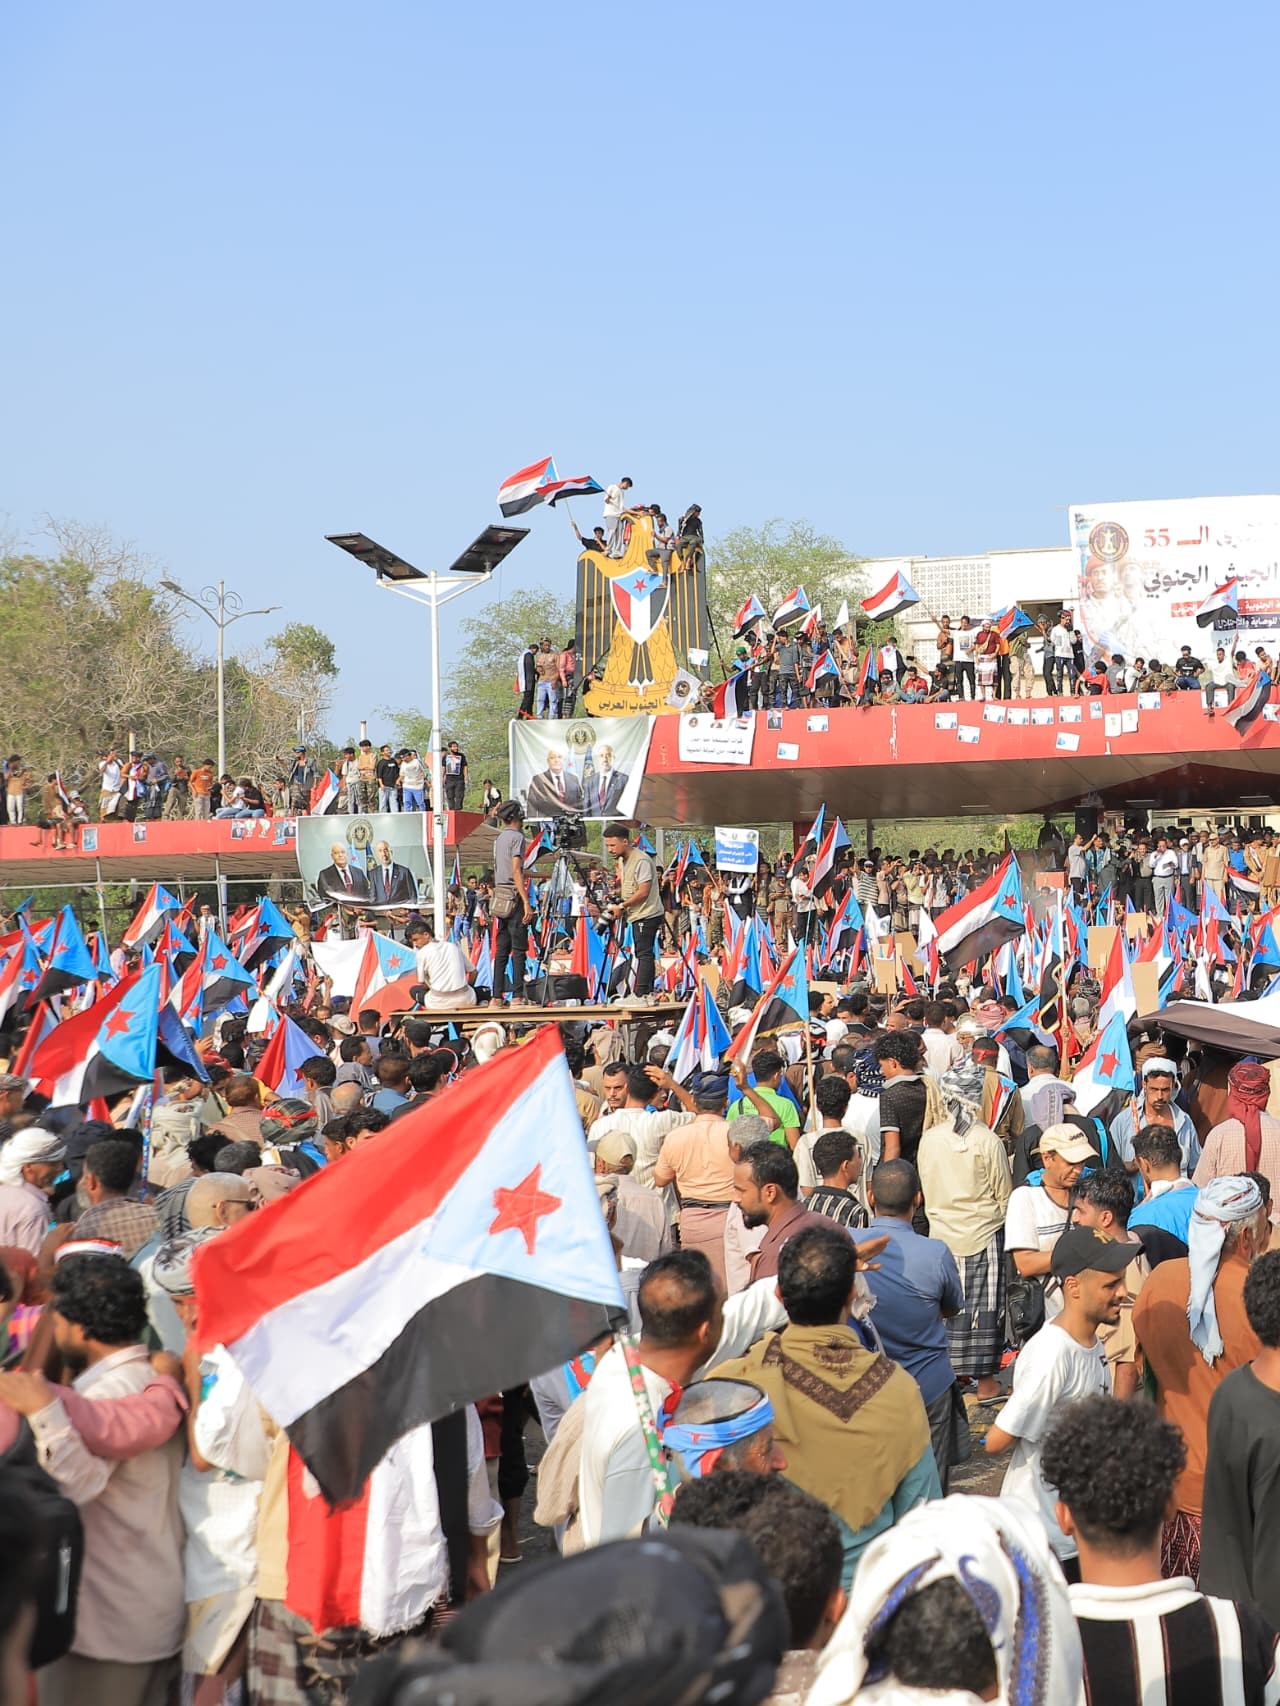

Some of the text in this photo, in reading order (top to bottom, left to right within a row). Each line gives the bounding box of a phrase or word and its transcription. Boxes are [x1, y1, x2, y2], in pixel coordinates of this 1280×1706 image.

[1143, 528, 1171, 548] 55
[1143, 564, 1209, 599] الجنوبي
[1214, 562, 1278, 591] الجيش
[598, 699, 628, 711] العربي
[629, 697, 661, 713] الجنوب
